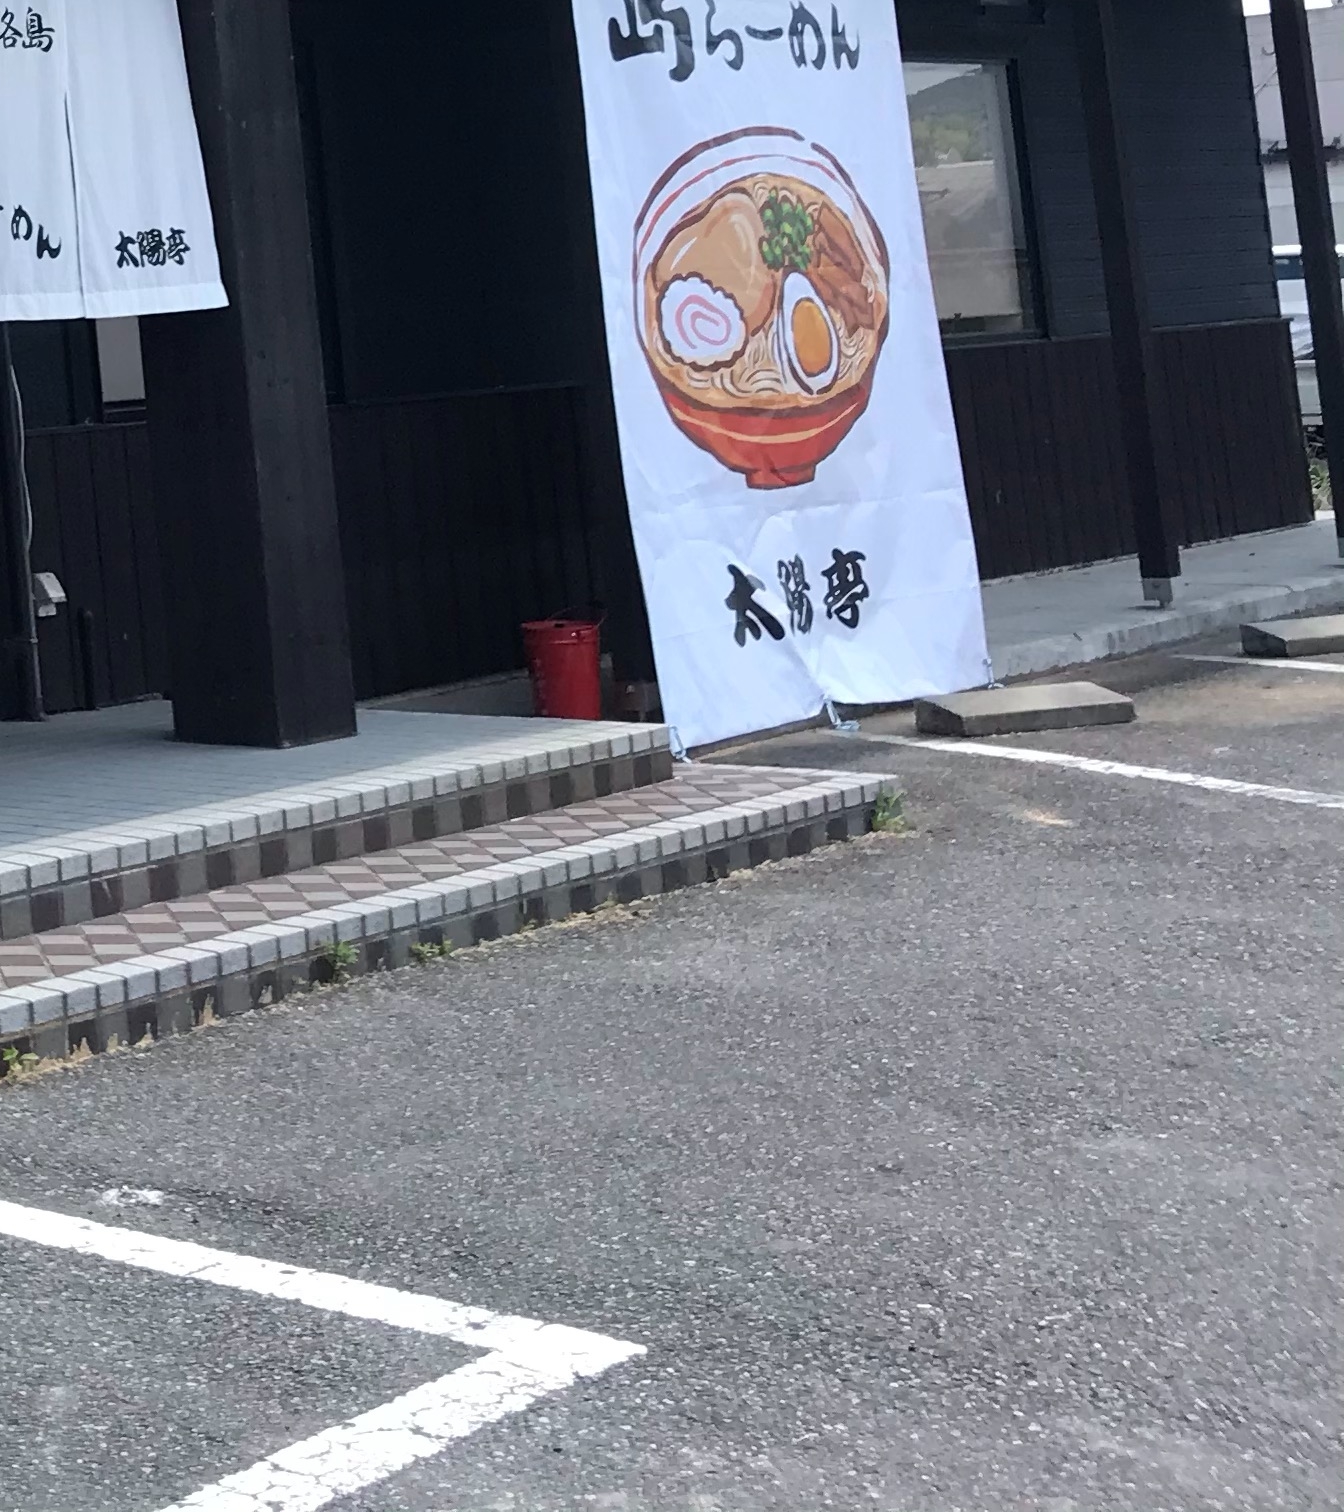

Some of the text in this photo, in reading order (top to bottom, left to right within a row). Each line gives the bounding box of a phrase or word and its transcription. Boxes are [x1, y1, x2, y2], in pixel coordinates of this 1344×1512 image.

[114, 227, 191, 269] 太陽亭
[724, 547, 870, 648] 太陽亭
